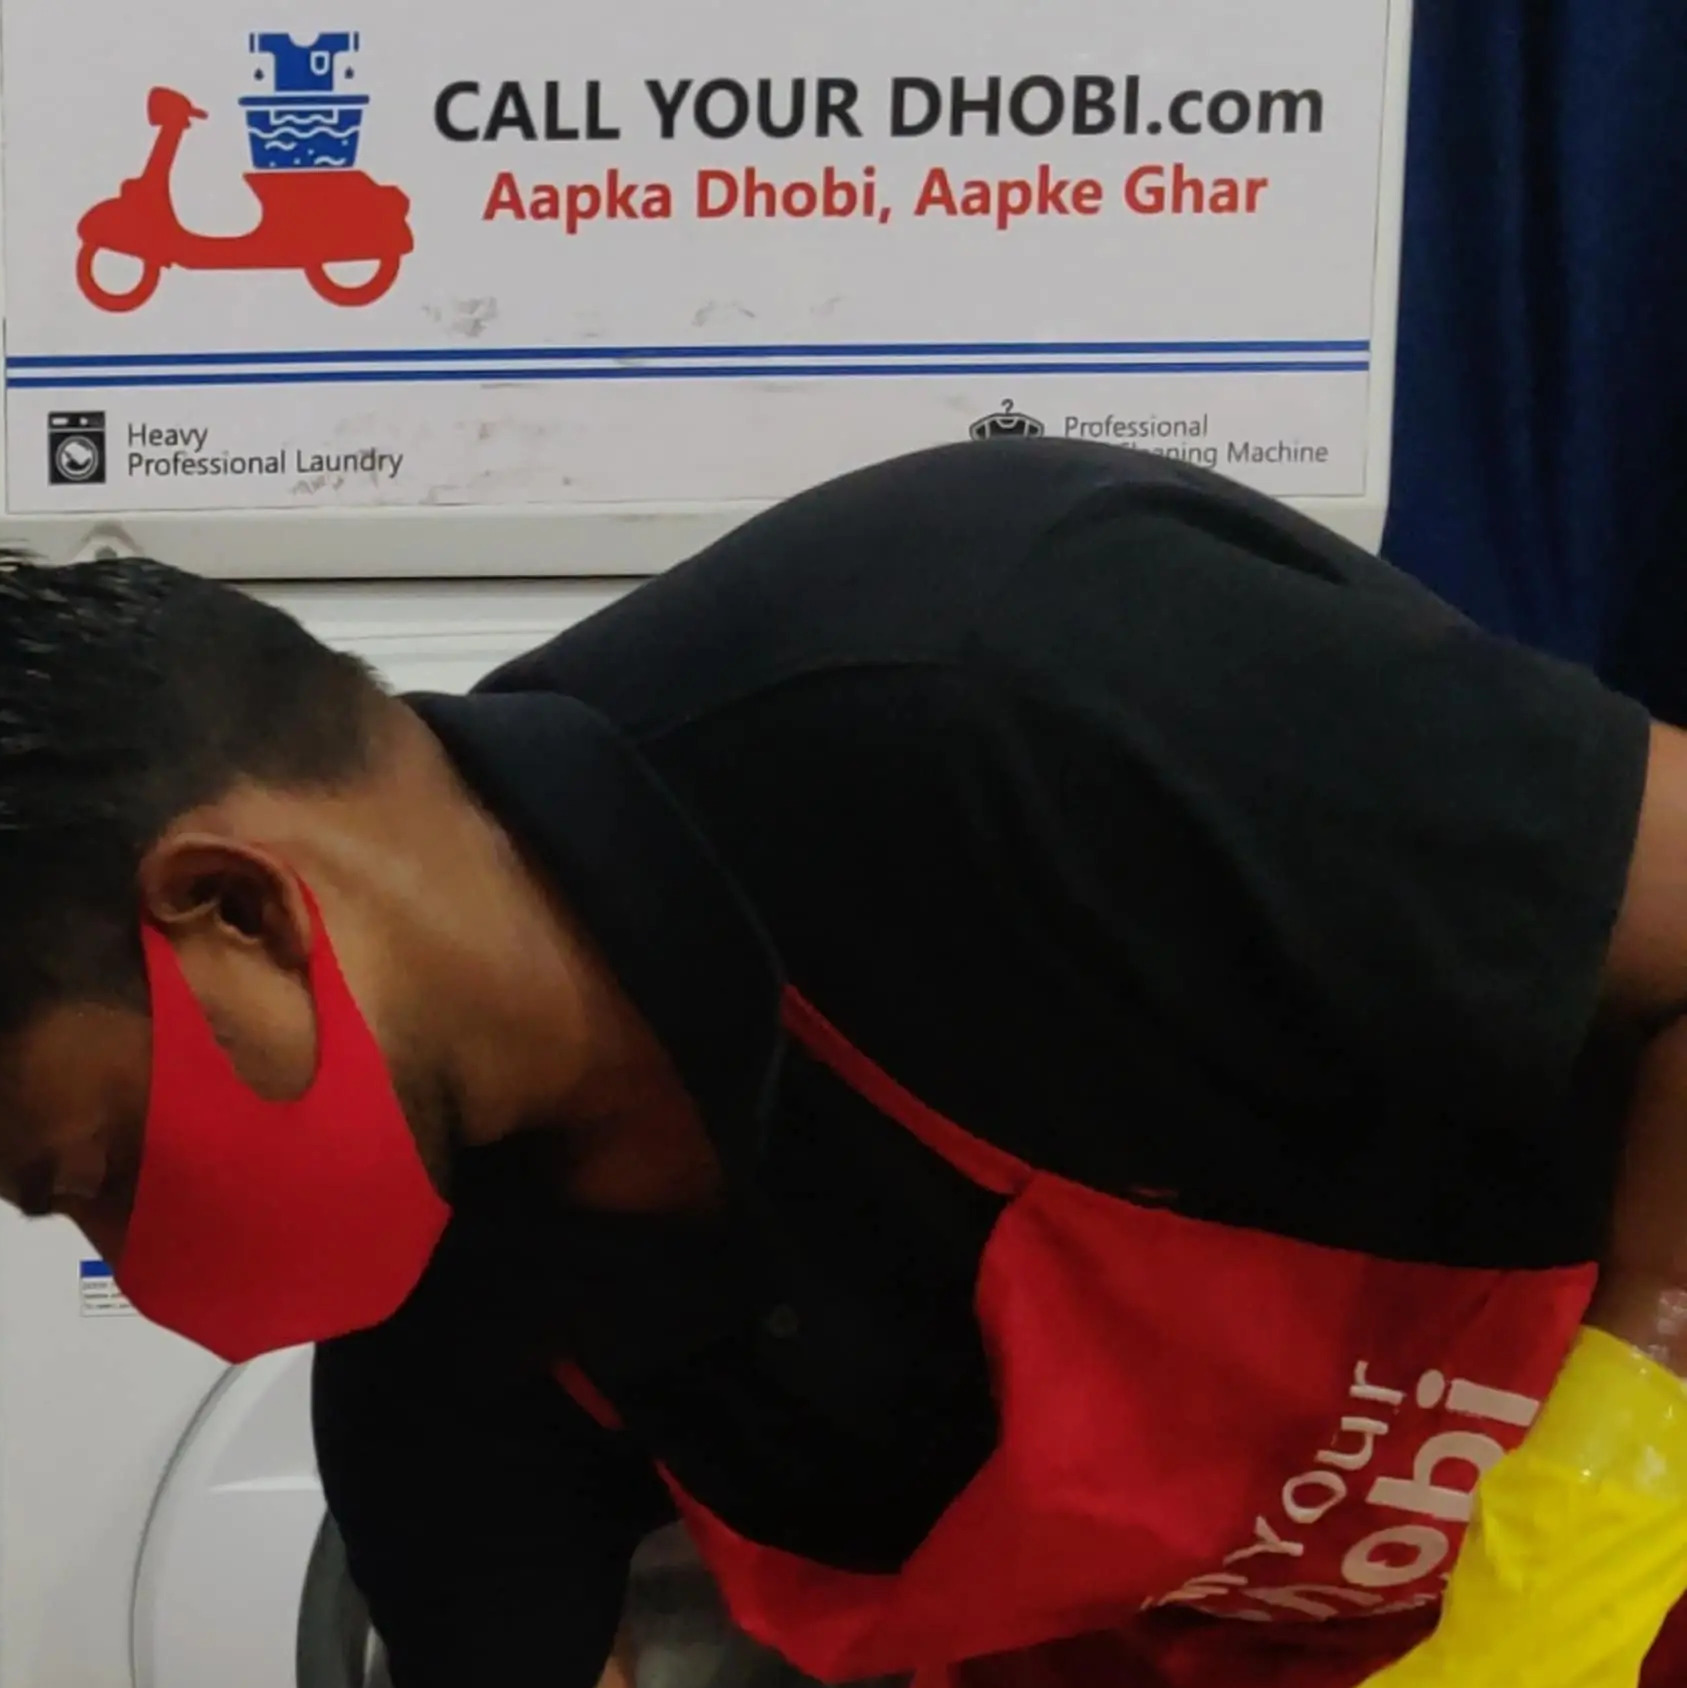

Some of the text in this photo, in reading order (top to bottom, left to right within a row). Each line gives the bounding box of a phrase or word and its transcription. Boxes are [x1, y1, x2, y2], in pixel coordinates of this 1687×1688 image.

[434, 74, 1323, 142] CALL YOUR DHOBI.com
[483, 163, 1270, 235] Aapka Dhobi, Aapke Ghar
[128, 423, 209, 453] Heavy
[1064, 413, 1209, 438] Professional
[128, 448, 404, 479] Professional Laundry
[1227, 440, 1329, 464] Machine
[1227, 1368, 1540, 1624] hobi
